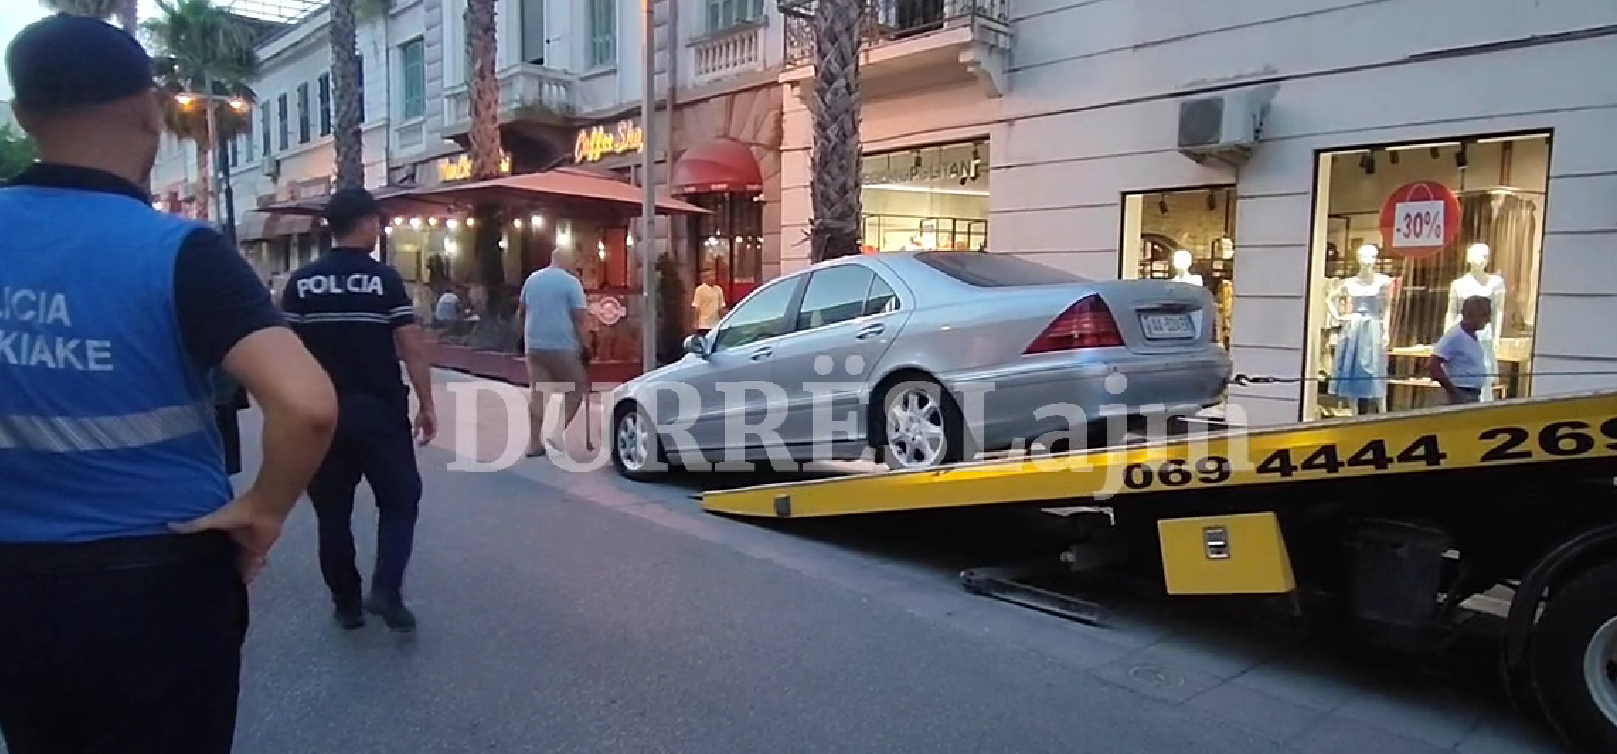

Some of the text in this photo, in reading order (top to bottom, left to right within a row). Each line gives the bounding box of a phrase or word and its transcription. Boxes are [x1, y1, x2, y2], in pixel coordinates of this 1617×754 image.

[1396, 211, 1441, 239] -30%
[0, 286, 71, 327] ICIA
[1123, 456, 1231, 491] 069
[1256, 434, 1447, 477] 4444
